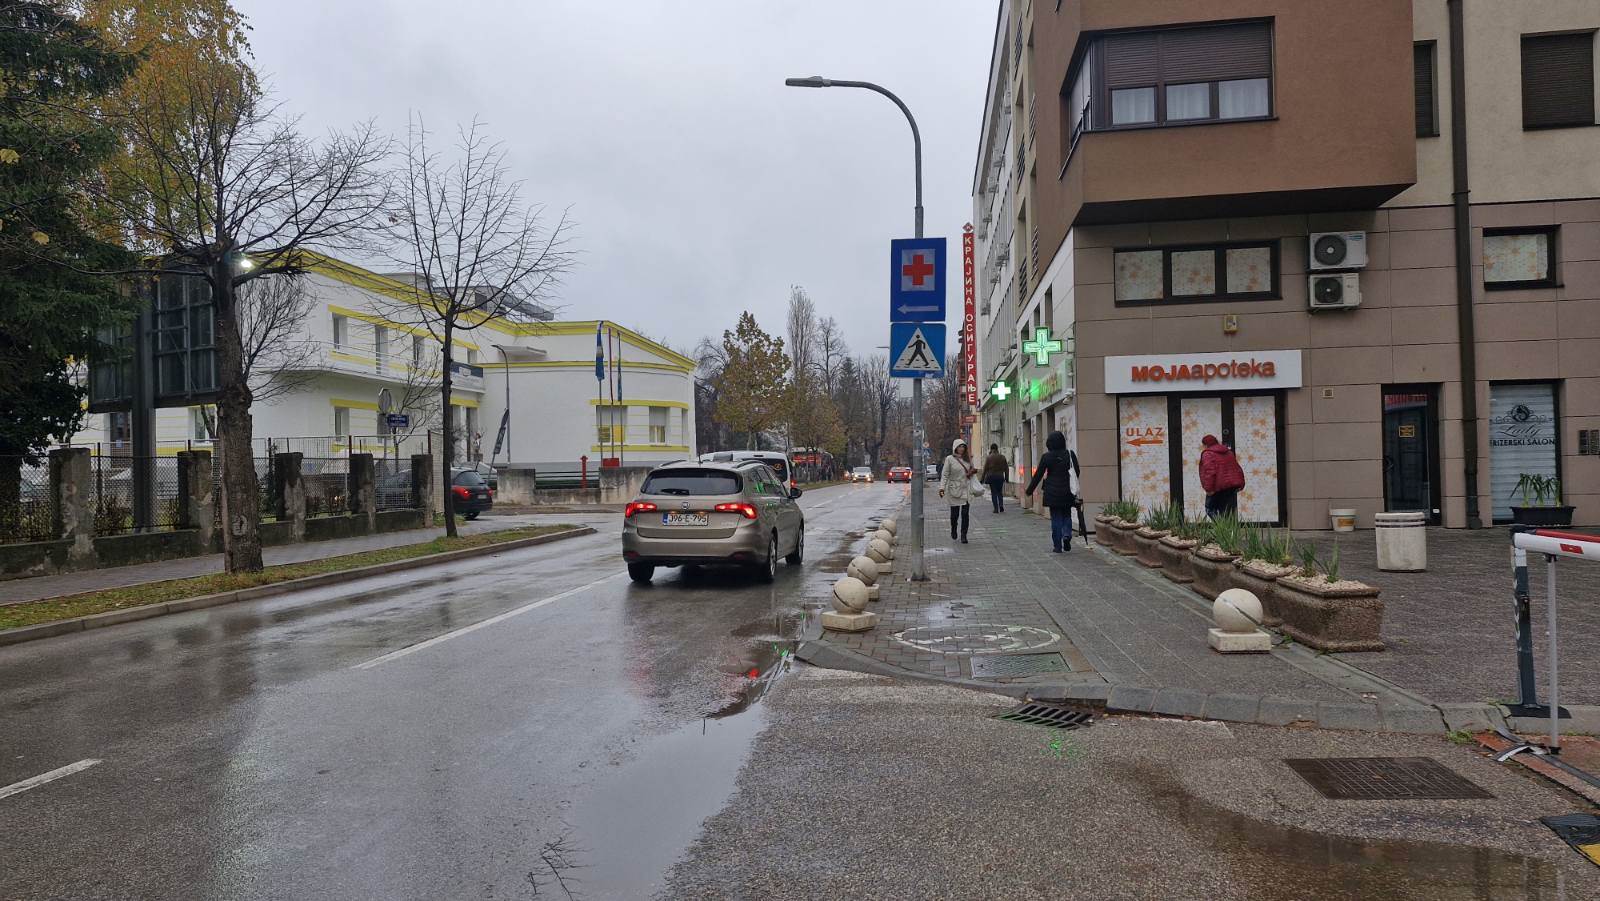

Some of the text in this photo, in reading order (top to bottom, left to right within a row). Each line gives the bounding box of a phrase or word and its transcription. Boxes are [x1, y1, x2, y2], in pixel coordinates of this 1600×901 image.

[964, 236, 976, 402] КРАЈИНА ОСИГУРАЊЕ
[1131, 358, 1276, 384] MOJAapoteka
[1126, 427, 1164, 437] ULAZ
